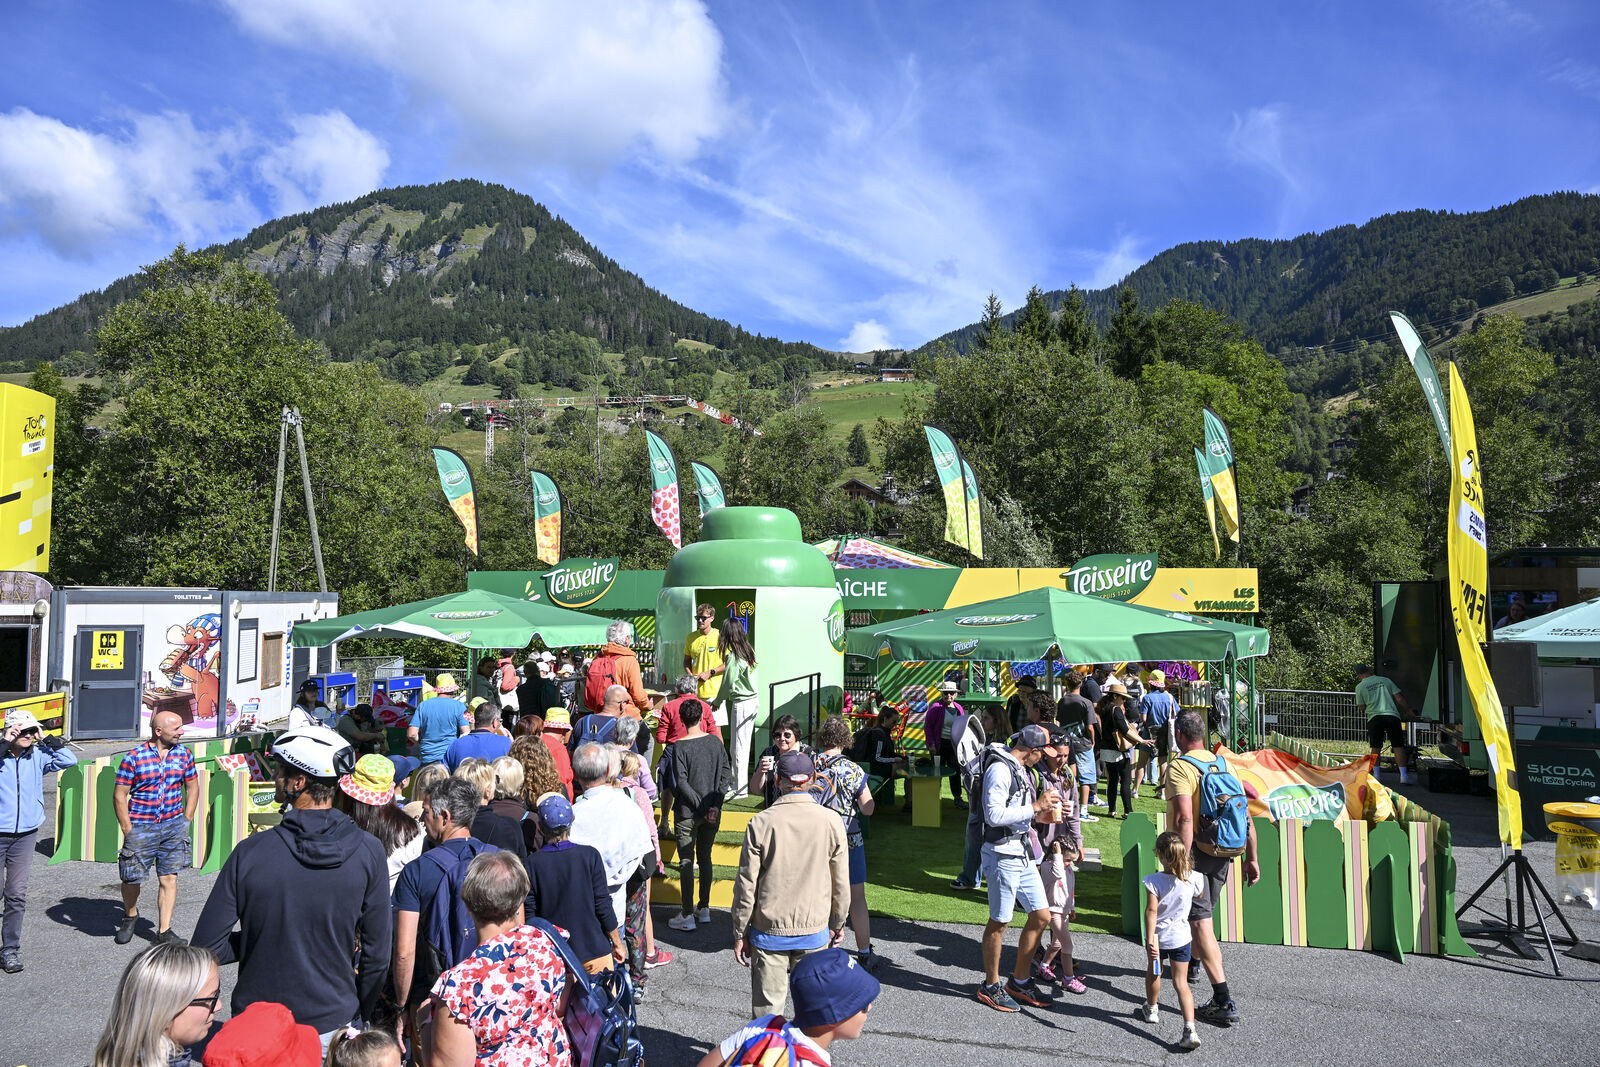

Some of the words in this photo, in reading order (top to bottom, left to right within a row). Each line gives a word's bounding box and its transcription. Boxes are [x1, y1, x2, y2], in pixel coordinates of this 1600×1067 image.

[542, 561, 614, 596] Teisseire
[1062, 558, 1153, 595] Teisseire
[566, 591, 585, 600] DEPUIS
[584, 589, 596, 597] 1720
[1117, 588, 1131, 596] 1720
[1233, 588, 1256, 598] LES
[1193, 599, 1256, 611] VITAMINÉS
[98, 648, 112, 656] WC
[952, 639, 979, 653] Teisseire
[281, 748, 321, 775] S-WORKS
[1528, 775, 1541, 783] We
[1565, 778, 1596, 788] Cycling
[1262, 789, 1342, 820] Teisseire
